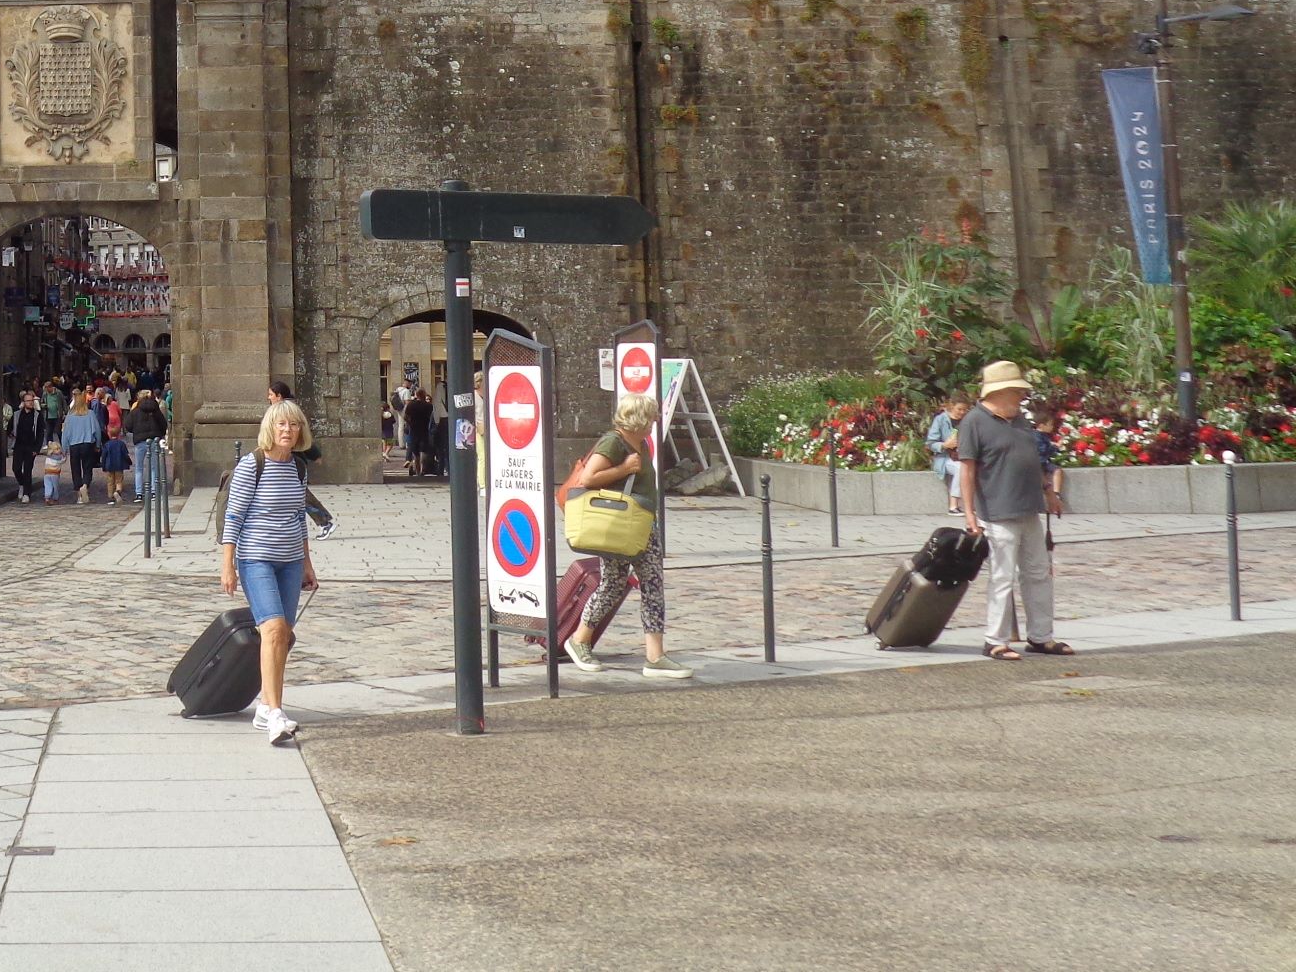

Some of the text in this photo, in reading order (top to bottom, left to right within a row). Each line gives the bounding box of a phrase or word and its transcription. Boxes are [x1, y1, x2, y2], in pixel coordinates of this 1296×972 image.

[1131, 111, 1159, 245] PARIS 2024
[508, 457, 526, 468] SAUF
[501, 468, 534, 480] USAGERS
[495, 479, 542, 492] DE LA MAIRIE
